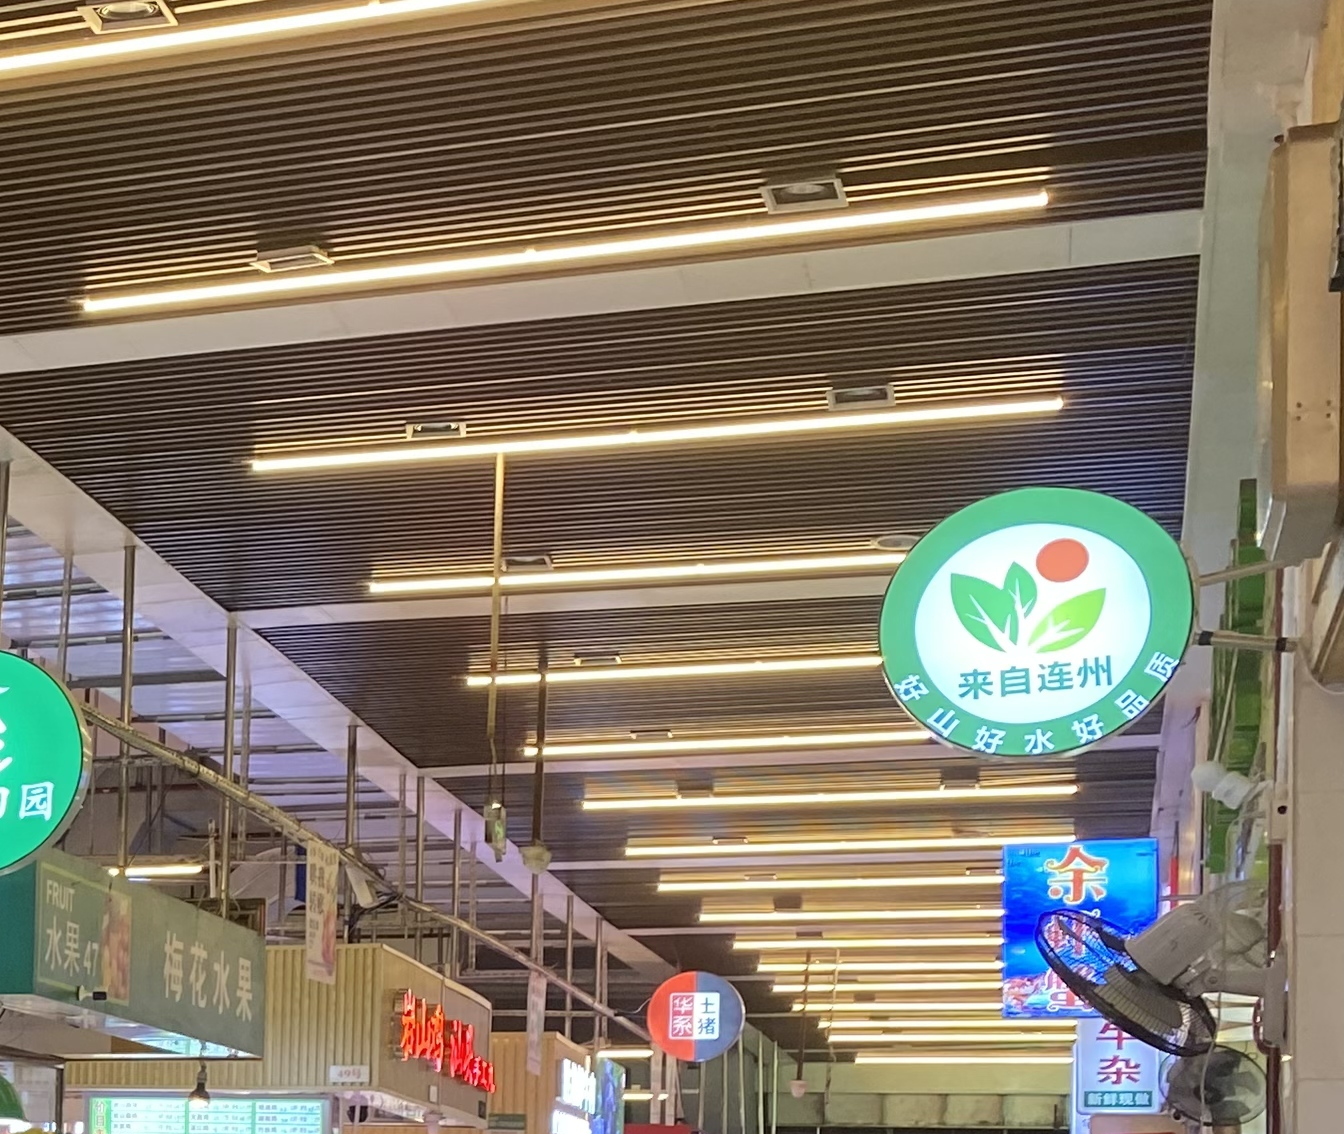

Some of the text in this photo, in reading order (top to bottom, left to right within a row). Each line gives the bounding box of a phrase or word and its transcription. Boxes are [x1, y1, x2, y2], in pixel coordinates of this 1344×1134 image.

[893, 651, 1180, 755] 好山好水好品质
[958, 654, 1114, 701] 来自连州
[45, 879, 76, 912] FRUIT
[44, 915, 100, 977] 水果 47
[163, 930, 253, 1023] 梅花水果
[1086, 1092, 1151, 1106] 新鲜现做
